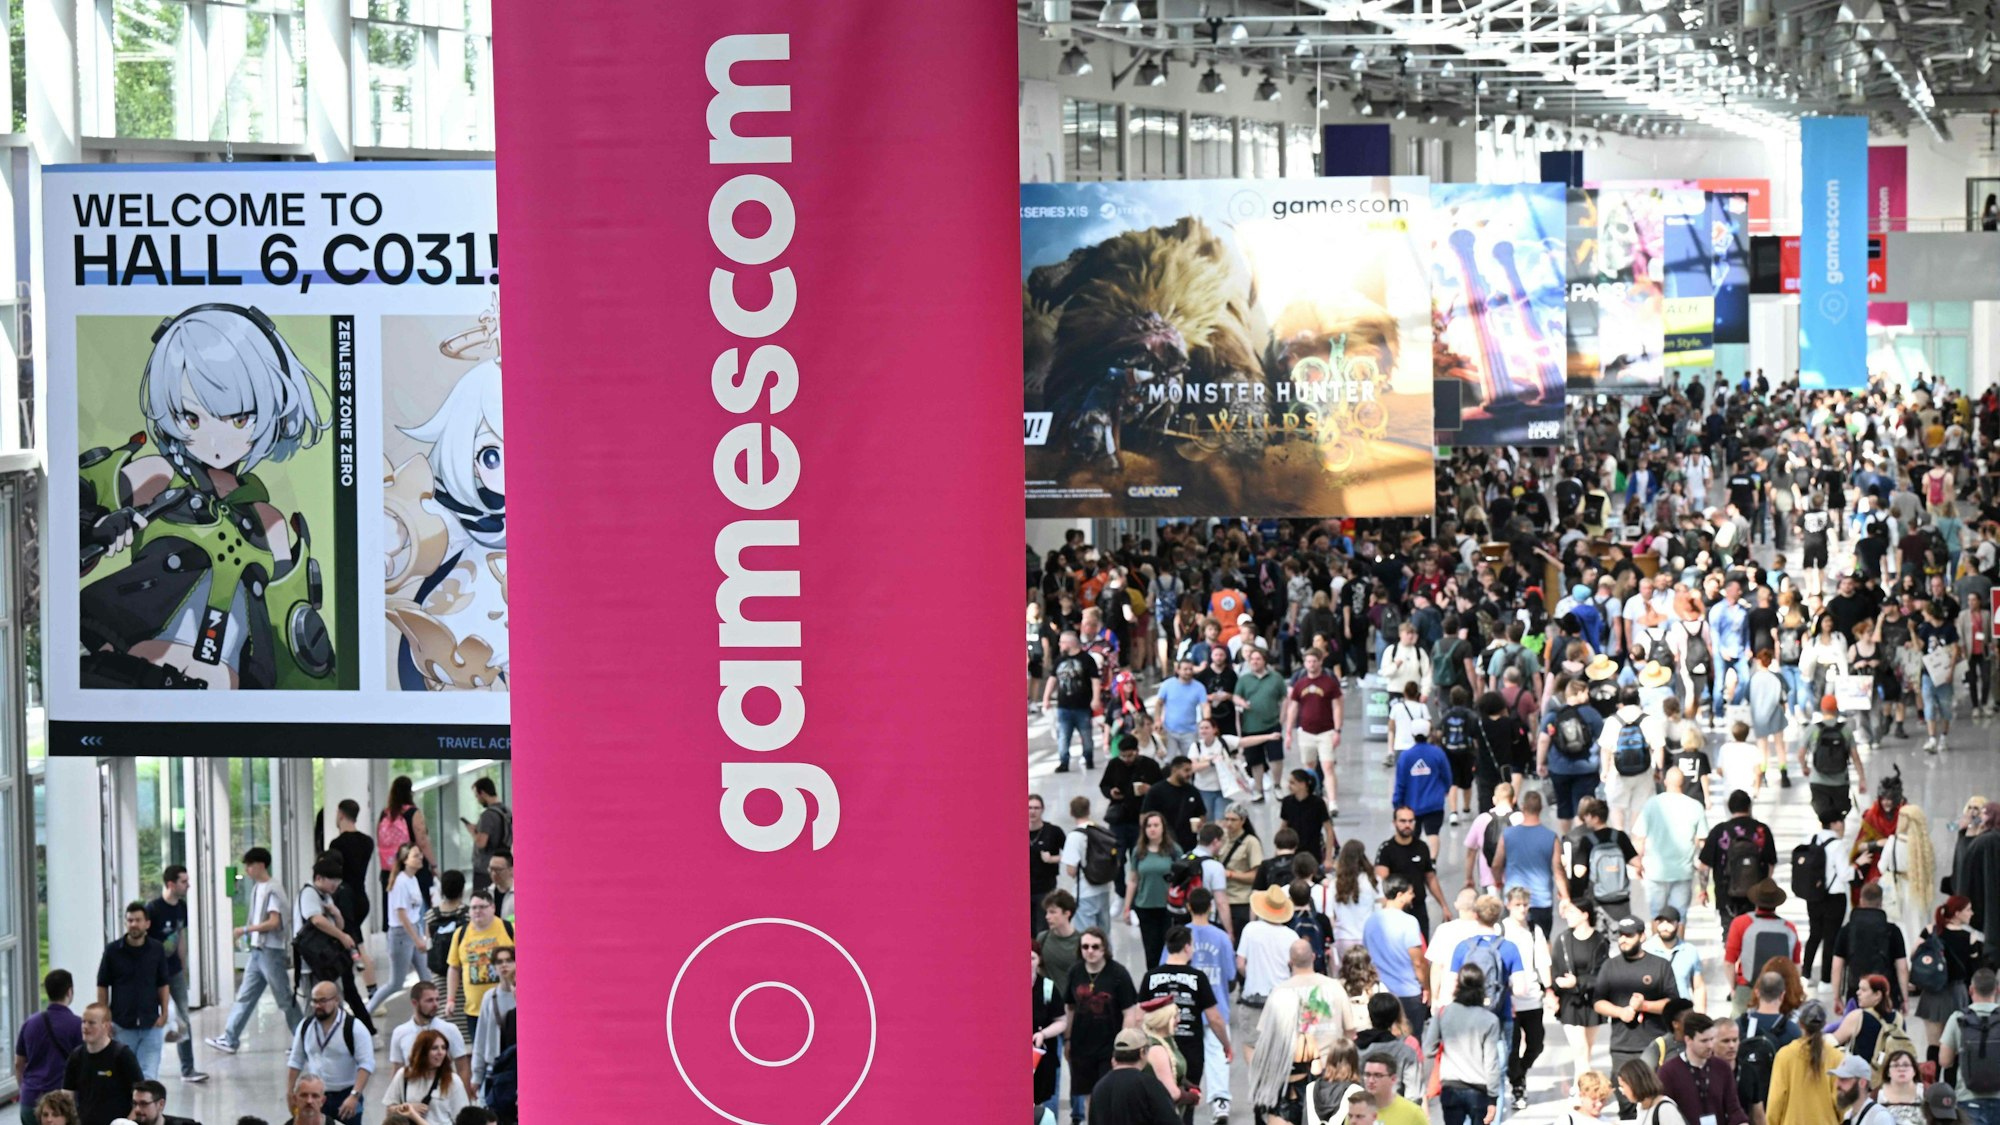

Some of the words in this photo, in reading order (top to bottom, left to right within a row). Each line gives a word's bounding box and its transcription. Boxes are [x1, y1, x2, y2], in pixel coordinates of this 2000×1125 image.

[73, 193, 305, 227] WELCOME
[320, 193, 383, 227] TO
[1024, 206, 1066, 218] SERIES
[1272, 197, 1409, 220] gamescom
[1826, 180, 1844, 284] gamescom
[75, 235, 243, 286] HALL
[338, 322, 352, 391] ZENLESS
[1148, 382, 1266, 404] MONSTER
[1277, 380, 1376, 403] HUNTER
[340, 396, 353, 438] ZONE
[1207, 408, 1319, 434] WILDS
[705, 34, 840, 852] gamescom
[340, 445, 354, 487] ZERO
[1127, 486, 1180, 498] CAPCOM
[437, 737, 486, 748] TRAVEL
